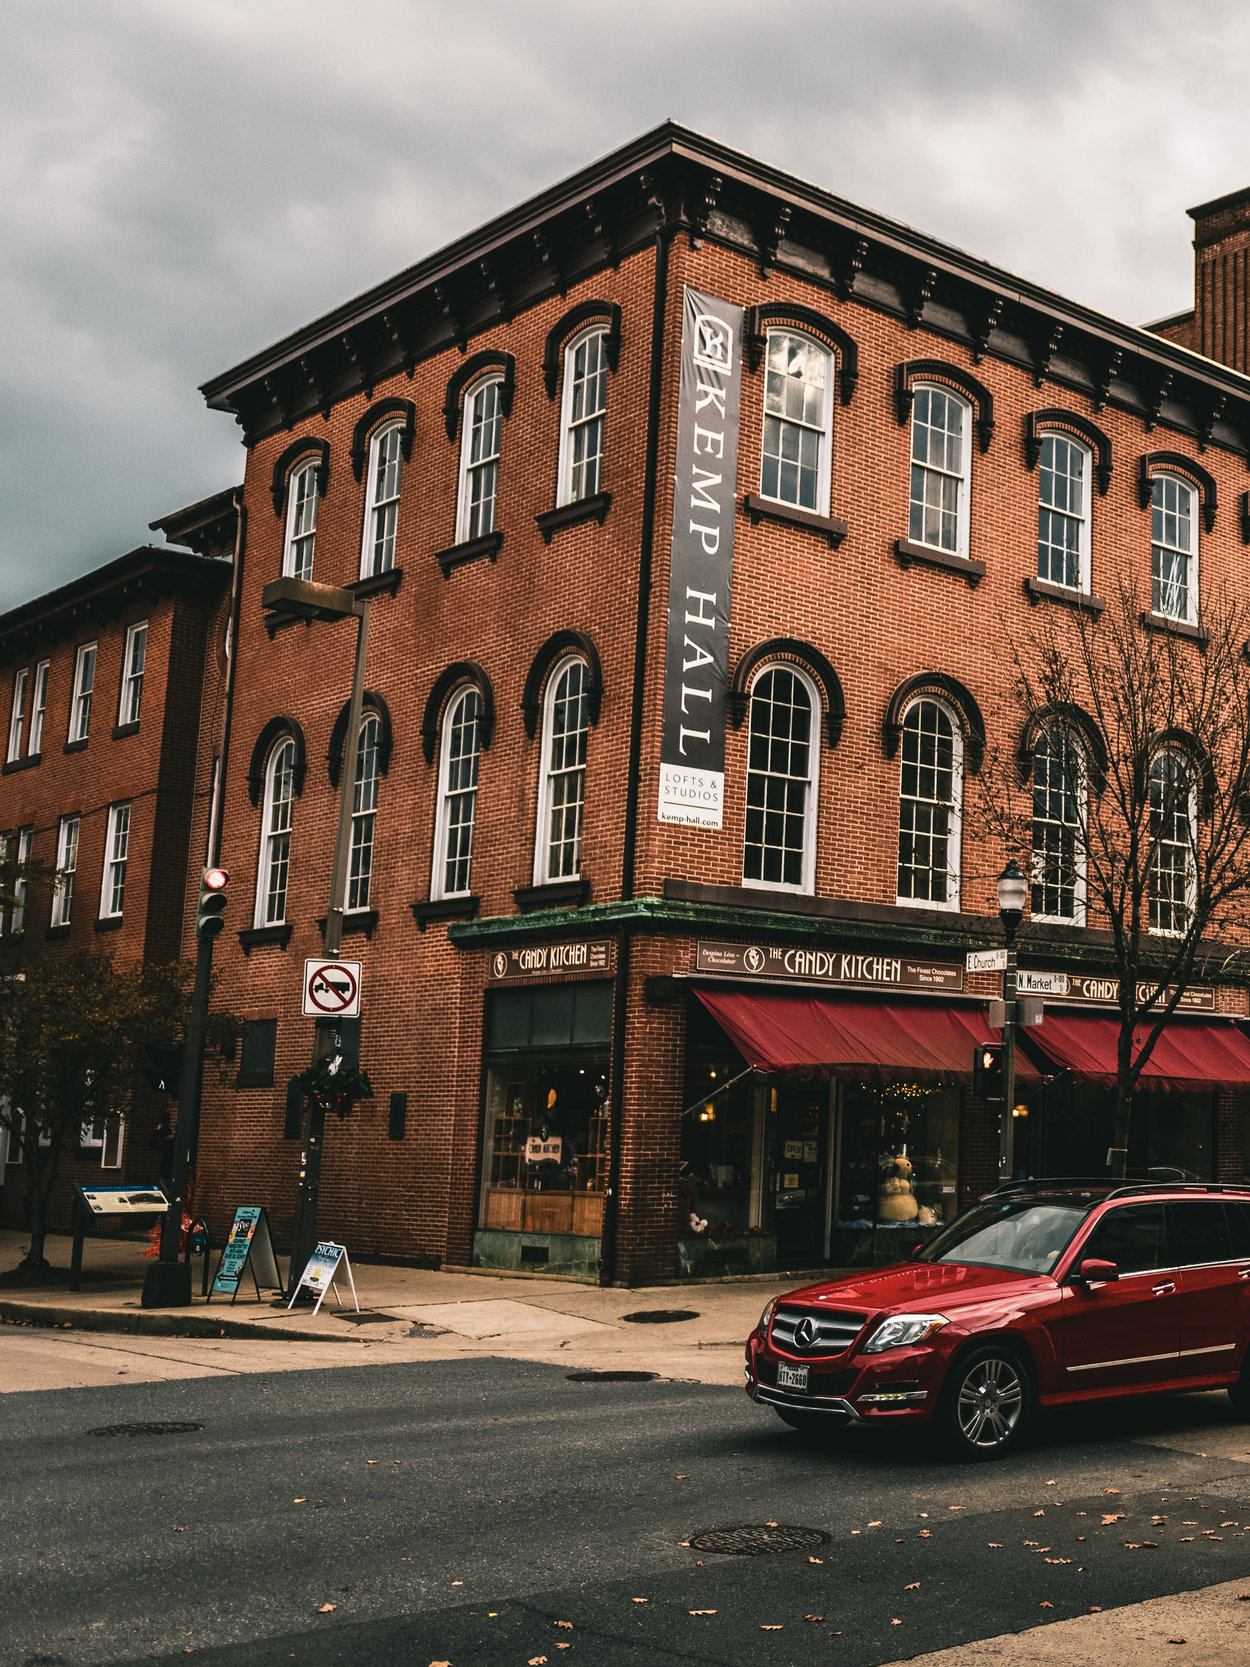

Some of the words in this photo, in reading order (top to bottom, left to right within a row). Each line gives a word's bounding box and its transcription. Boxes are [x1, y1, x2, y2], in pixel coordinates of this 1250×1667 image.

[689, 377, 727, 556] KEMP
[678, 585, 717, 757] HALL
[665, 772, 704, 787] LOFTS
[710, 780, 718, 790] &
[664, 785, 719, 802] STUDIOS
[661, 811, 719, 828] kemp-hall.com
[519, 947, 549, 970] CANDY
[549, 943, 588, 970] KITCHEN
[769, 947, 783, 960] THE
[784, 949, 837, 977] CANDY
[840, 954, 902, 982] KITCHEN
[973, 954, 996, 969] Church
[907, 966, 916, 974] The
[916, 966, 931, 974] Finest
[931, 968, 957, 977] Chocolates
[918, 974, 933, 982] Since
[1026, 974, 1052, 990] Market
[1072, 978, 1082, 987] THE
[1083, 980, 1120, 1000] CANDY
[786, 1144, 801, 1154] OPEN
[314, 1244, 342, 1258] PSYCHIC
